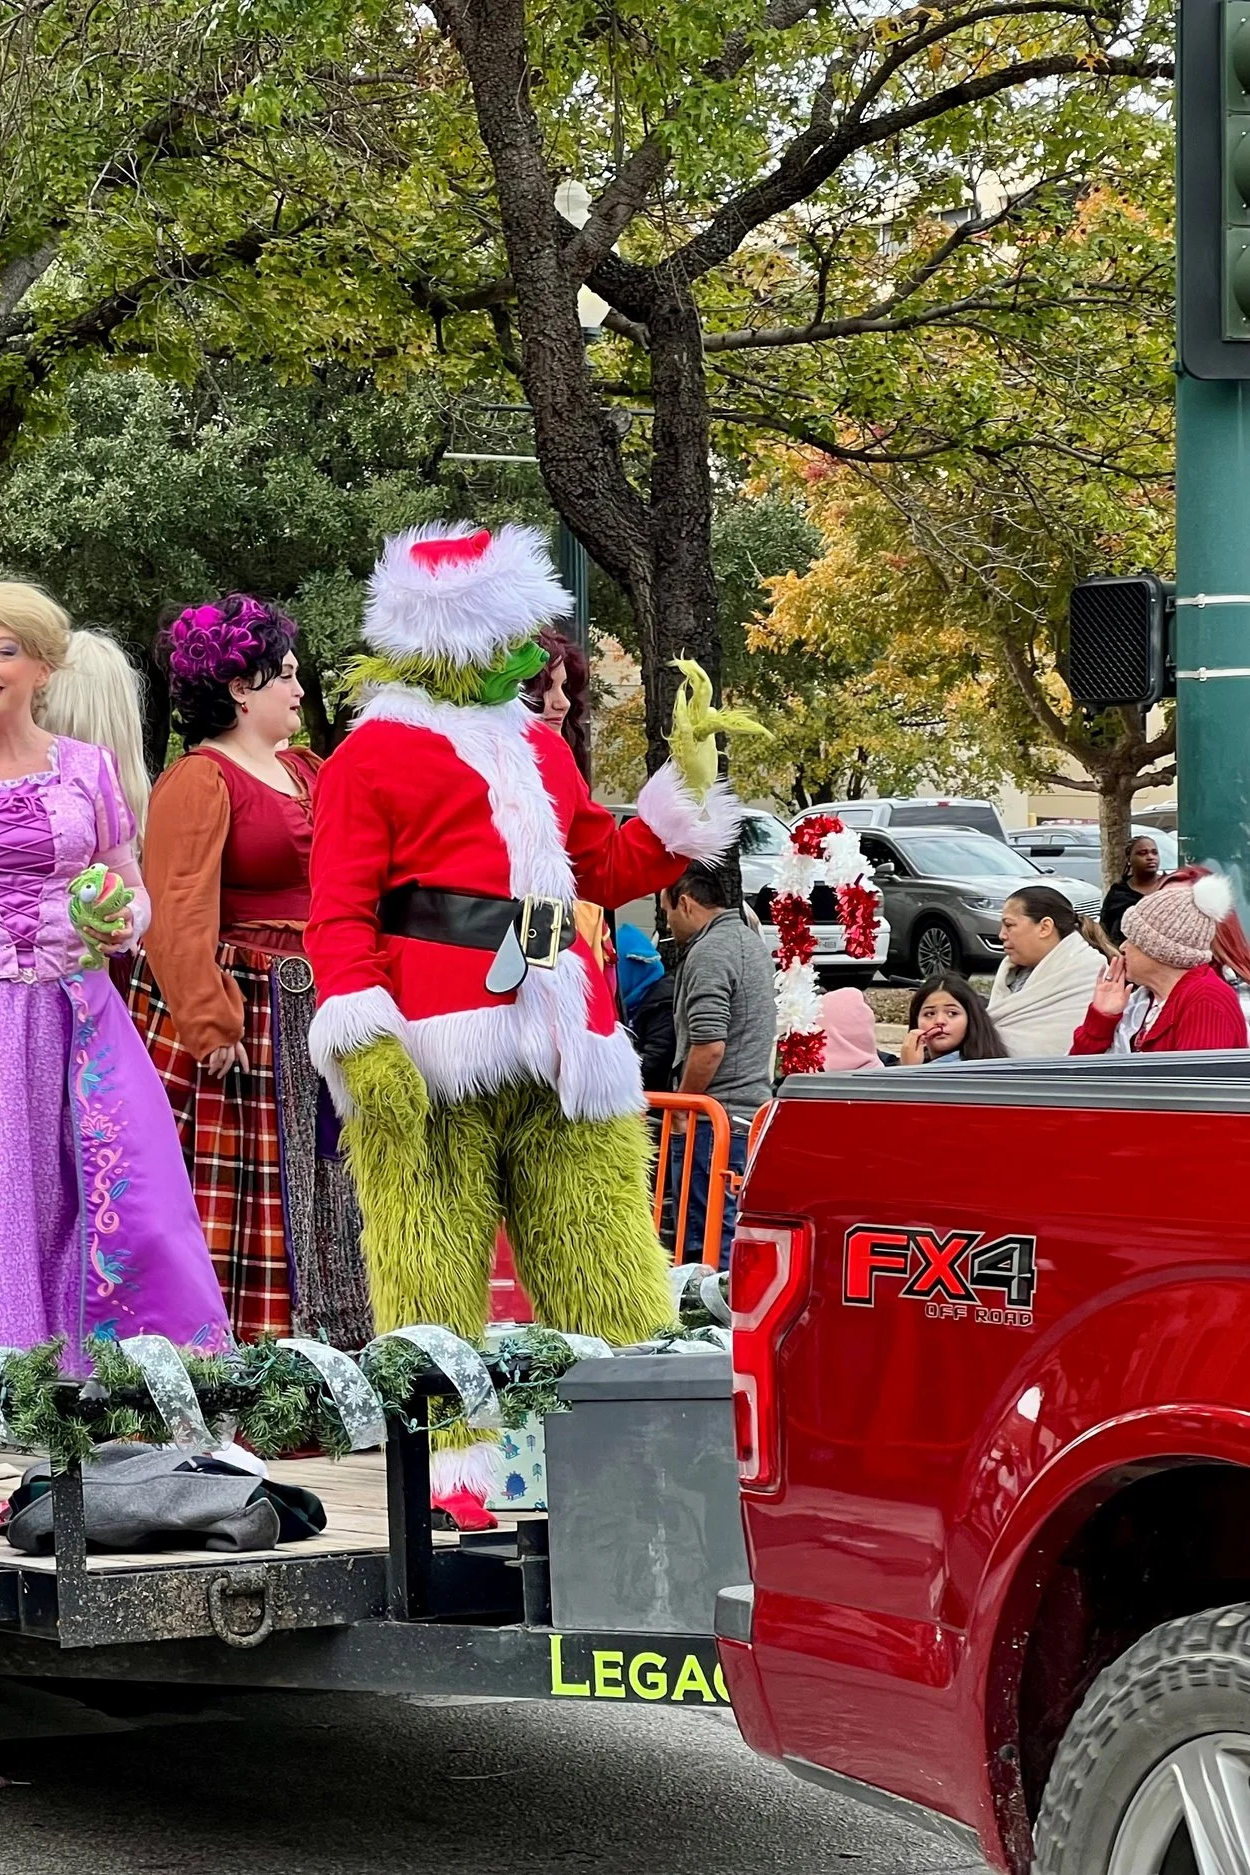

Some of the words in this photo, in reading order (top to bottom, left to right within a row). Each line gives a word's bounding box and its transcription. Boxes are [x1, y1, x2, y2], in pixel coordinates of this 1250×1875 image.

[842, 1223, 1037, 1310] FX4
[925, 1302, 967, 1320] OFF
[975, 1306, 1033, 1327] ROAD
